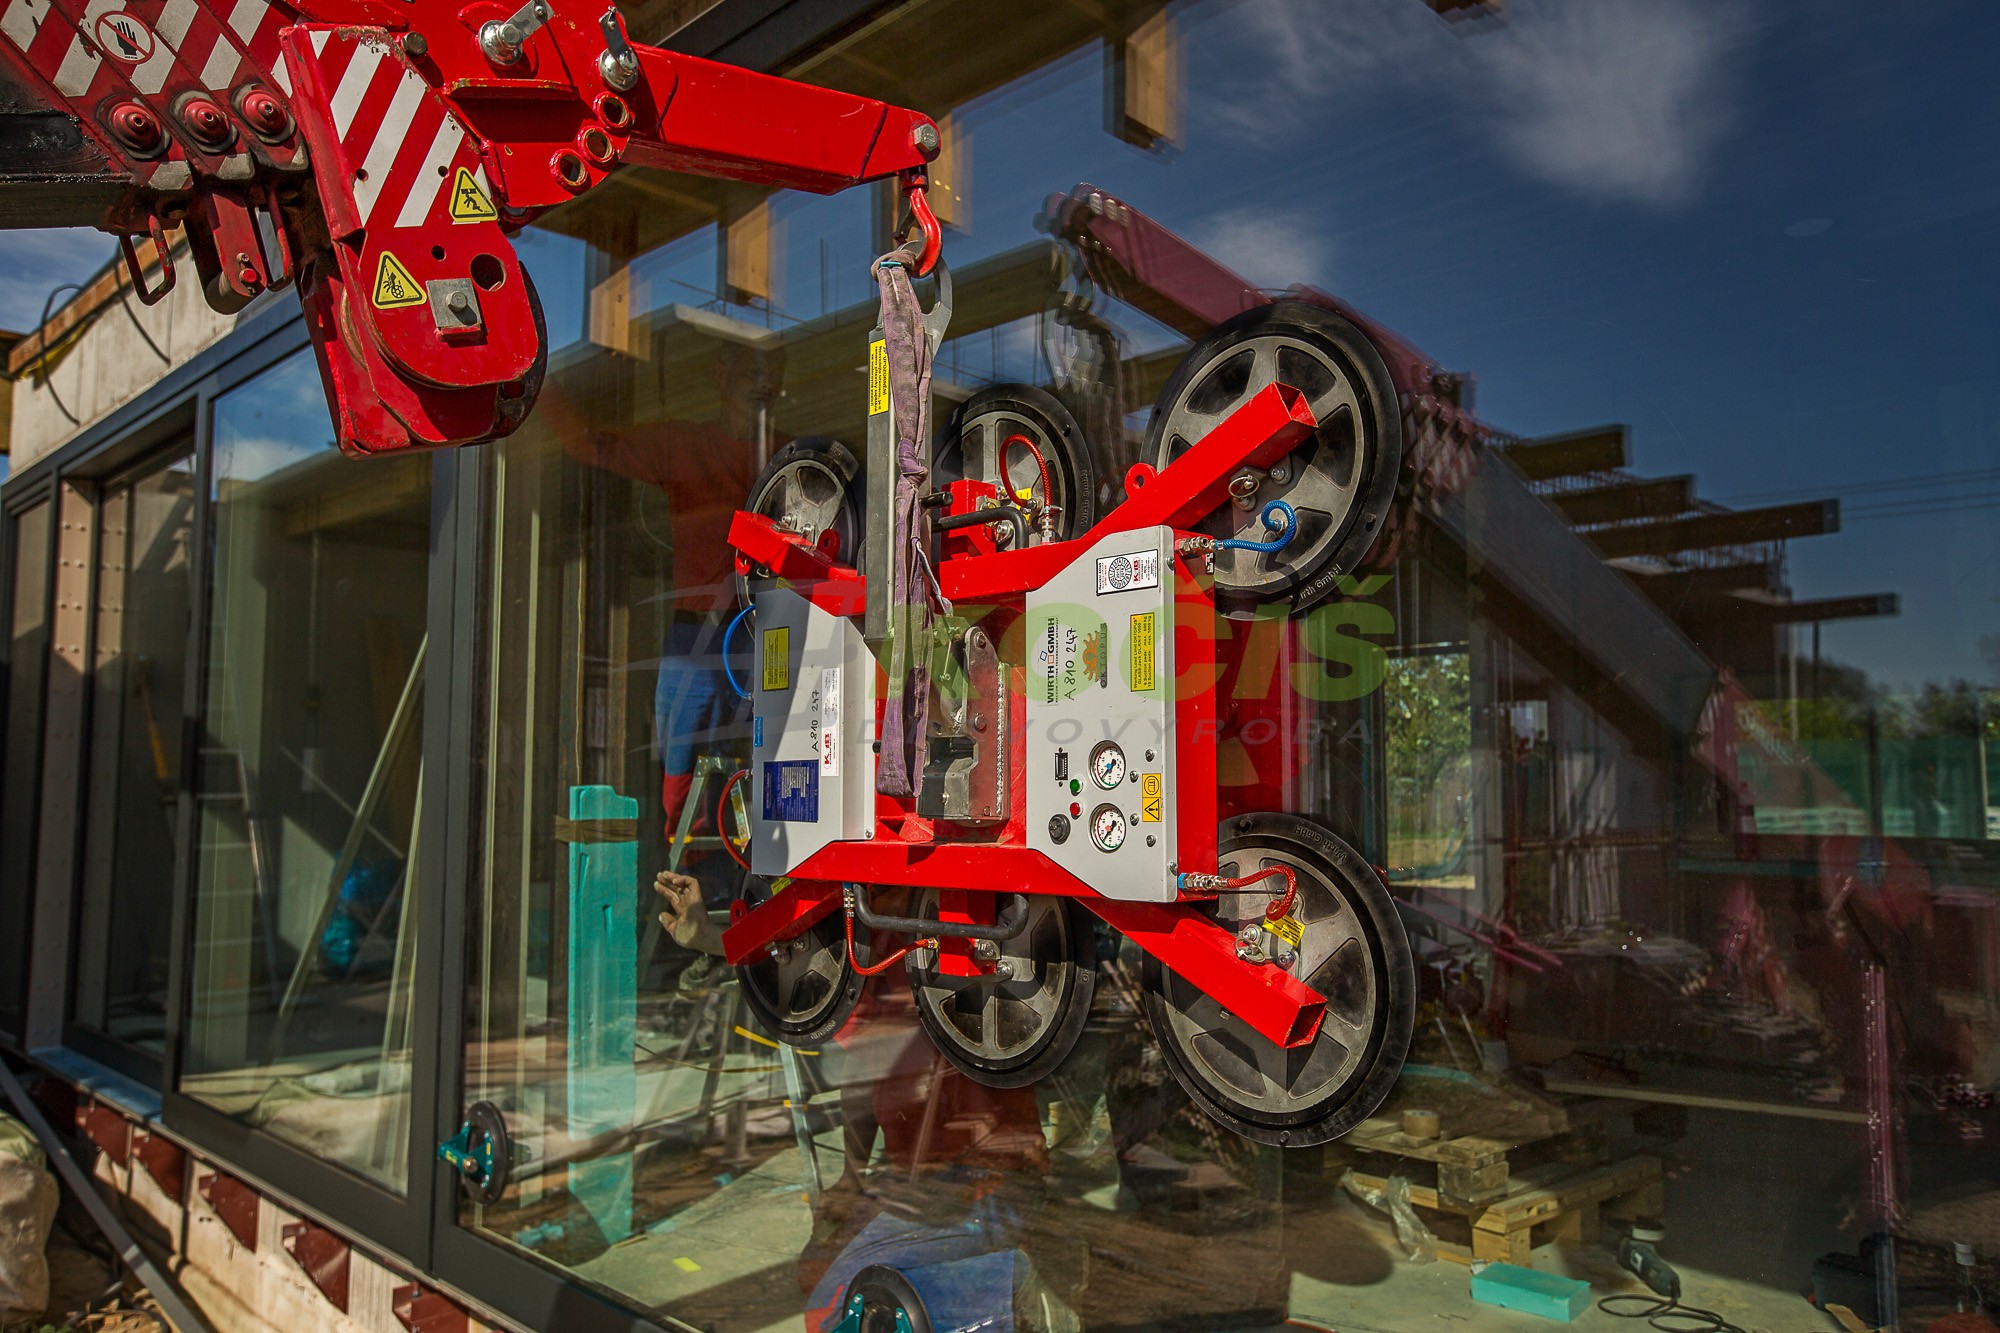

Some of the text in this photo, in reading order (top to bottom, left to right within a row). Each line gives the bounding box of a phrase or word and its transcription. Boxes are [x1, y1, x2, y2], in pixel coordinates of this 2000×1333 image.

[1065, 627, 1078, 653] 247
[1047, 618, 1055, 704] WIRTH GMBH
[1064, 660, 1076, 685] 810
[811, 690, 819, 712] 247
